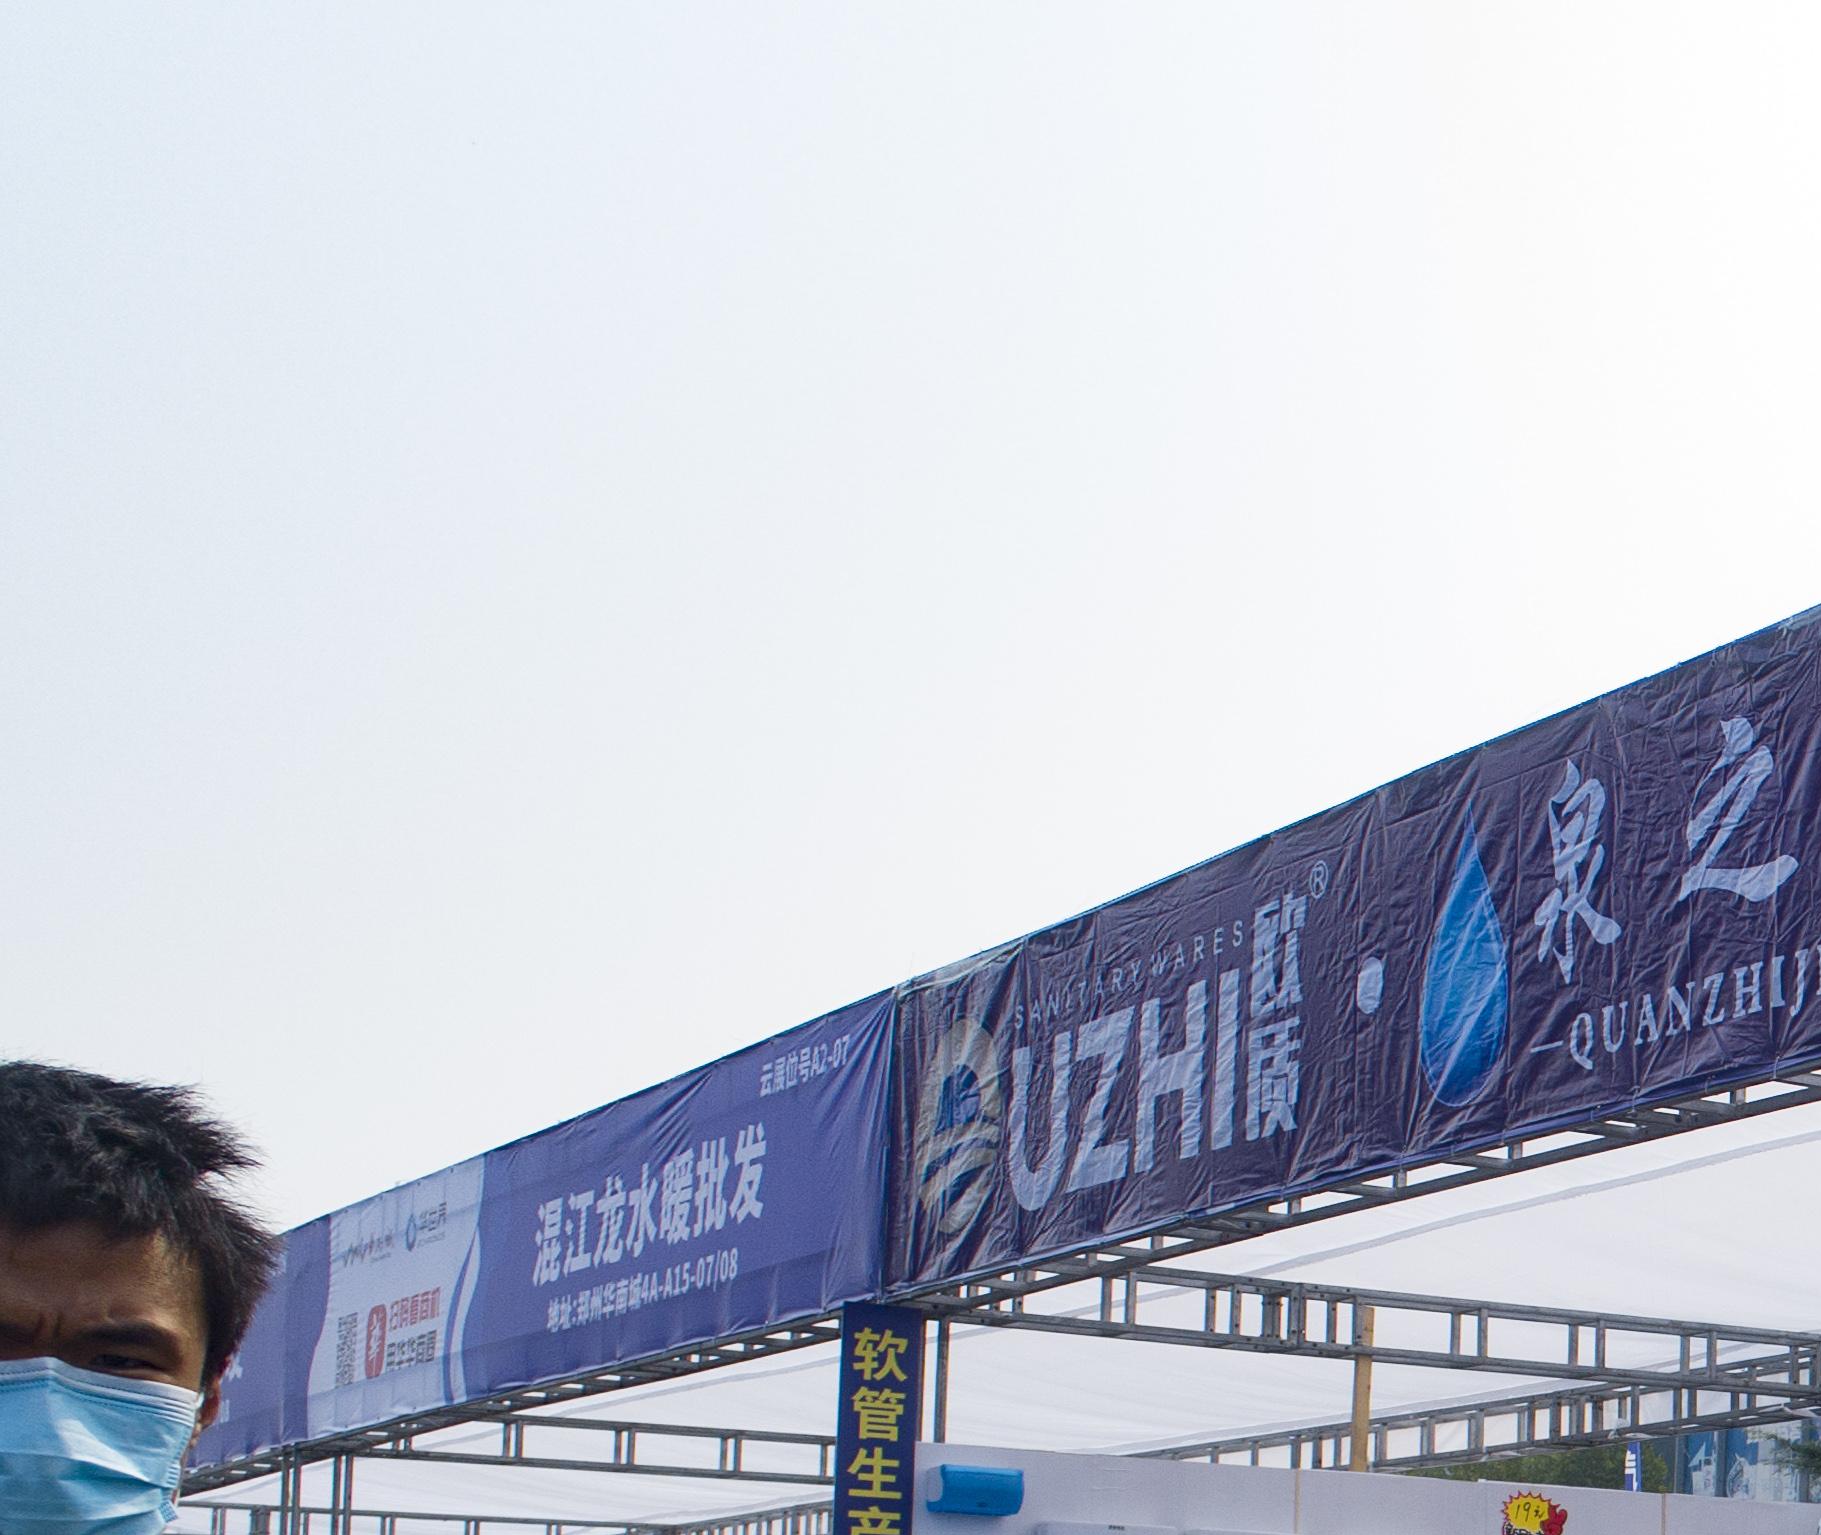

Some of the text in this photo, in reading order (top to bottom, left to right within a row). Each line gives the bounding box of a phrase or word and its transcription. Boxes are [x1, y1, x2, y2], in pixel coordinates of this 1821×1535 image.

[1151, 919, 1245, 977] WARES
[760, 1034, 849, 1097] 云展位号A2-07
[1245, 892, 1308, 1142] 欧质
[533, 1122, 766, 1287] 混江龙水暖批发
